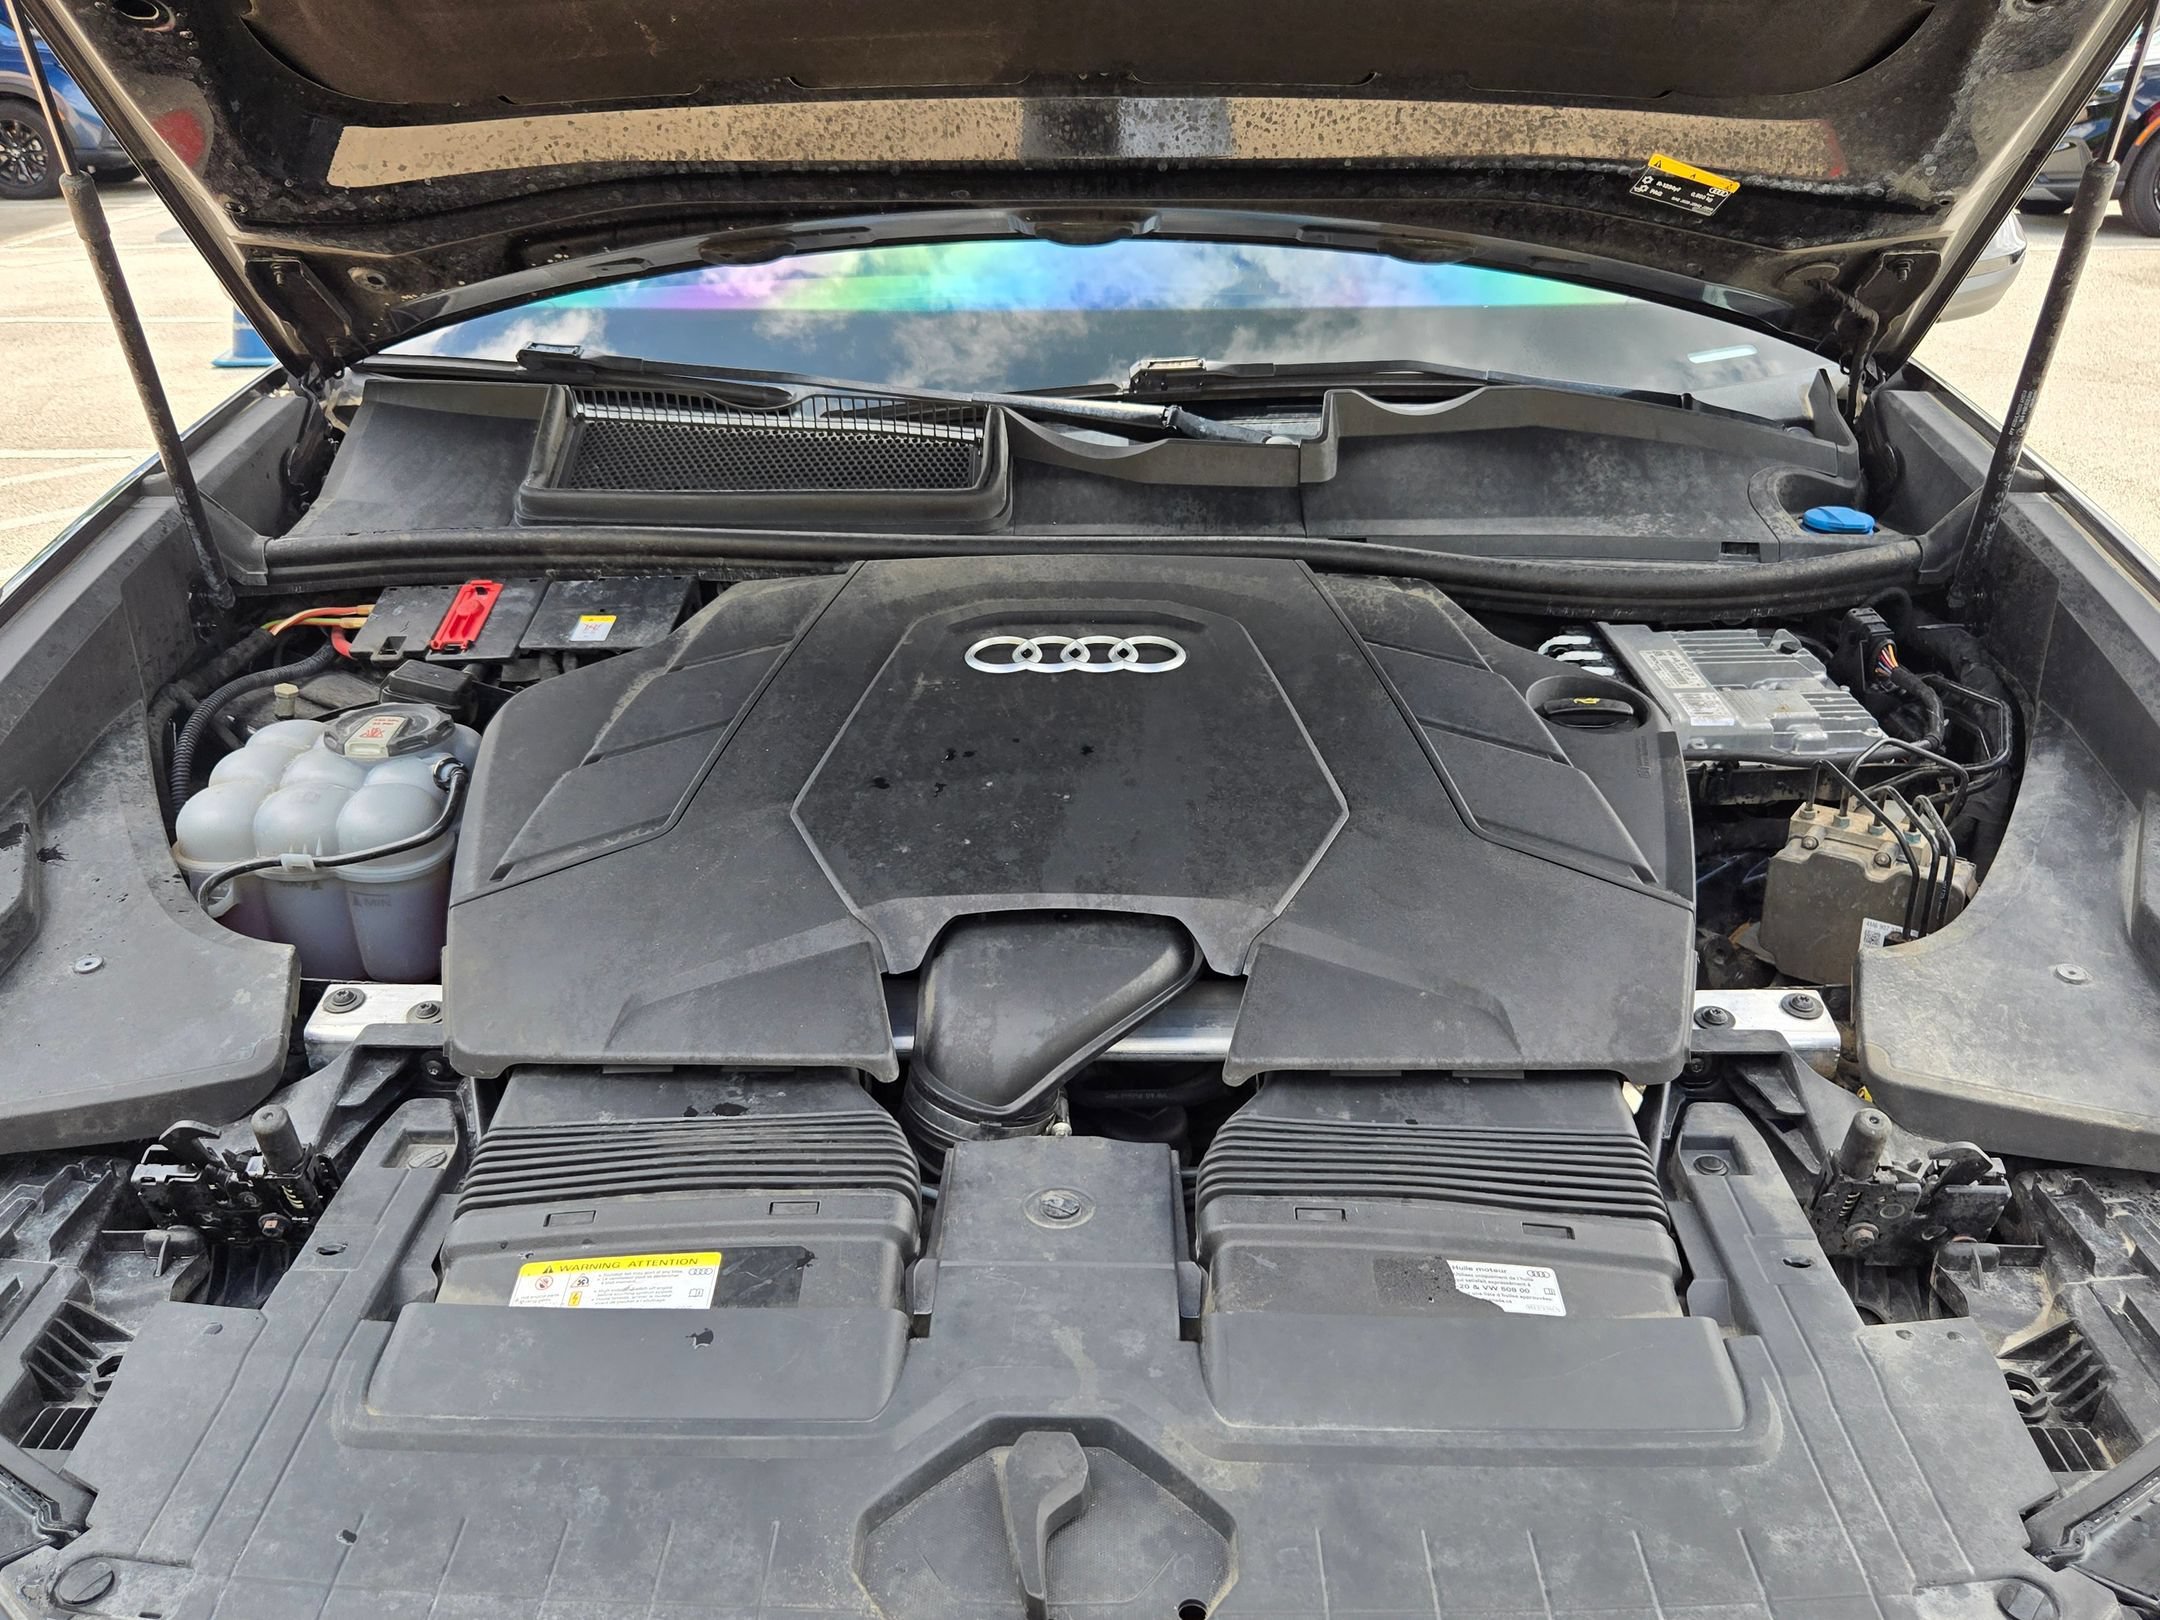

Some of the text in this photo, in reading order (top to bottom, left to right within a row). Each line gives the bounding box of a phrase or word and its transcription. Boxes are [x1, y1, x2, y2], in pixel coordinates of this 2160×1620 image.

[559, 1257, 699, 1272] WARNING ATTENTION
[1452, 1264, 1474, 1272] Huile
